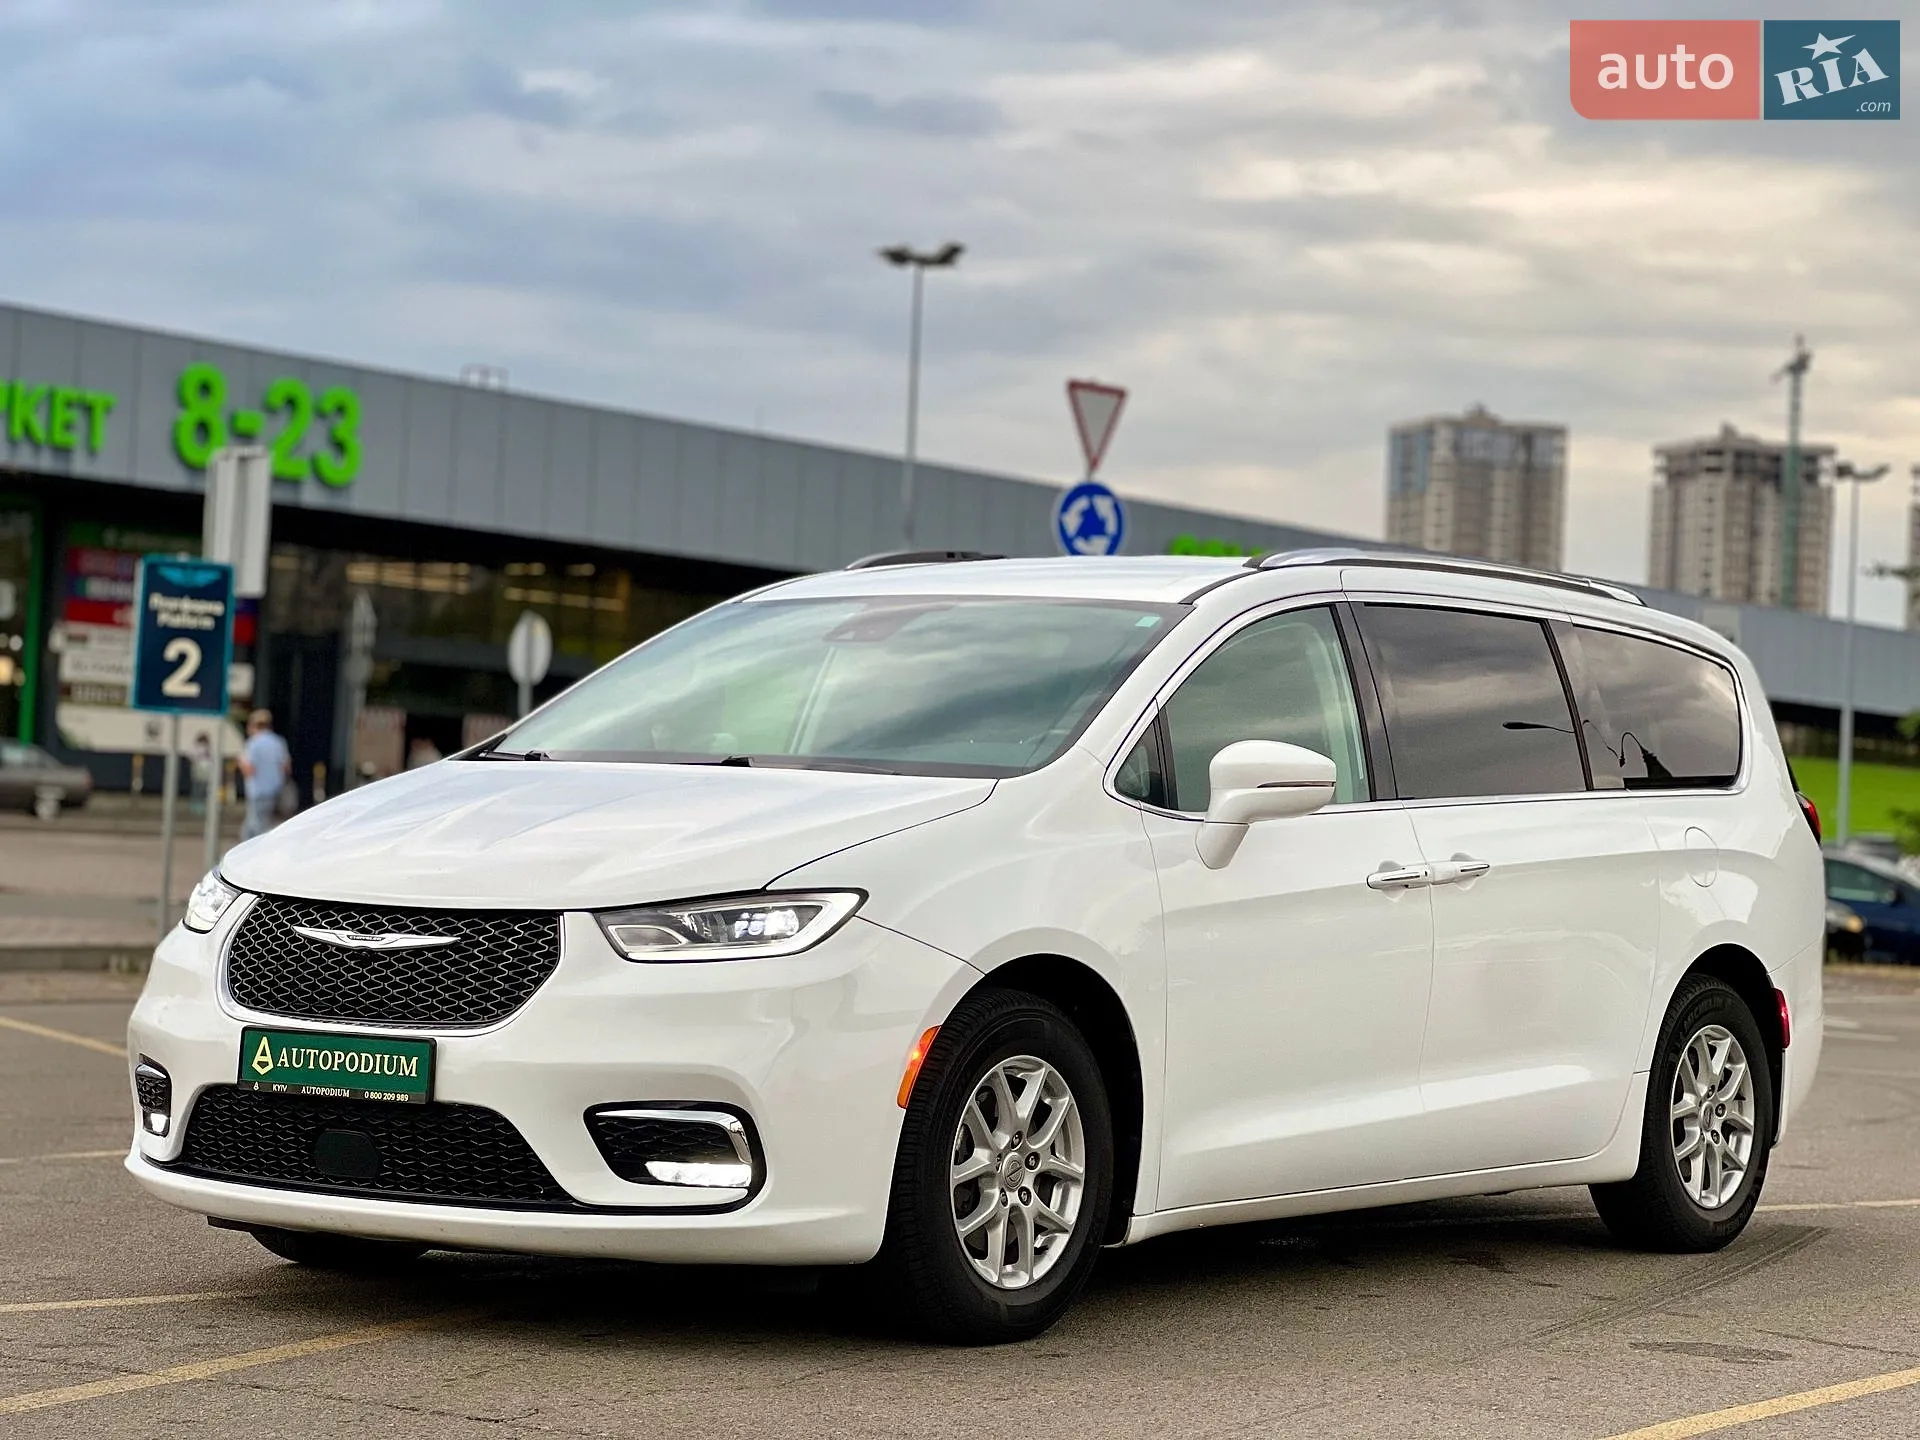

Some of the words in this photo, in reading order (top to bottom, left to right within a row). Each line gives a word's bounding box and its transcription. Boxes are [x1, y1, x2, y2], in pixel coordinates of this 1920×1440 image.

[174, 362, 364, 488] 8-23
[161, 637, 203, 698] 2
[277, 1047, 418, 1077] AUTOPODIUM
[272, 1083, 288, 1093] KYIV
[301, 1086, 350, 1098] AUTOPODIUM
[370, 1091, 382, 1100] 800
[383, 1092, 396, 1101] 209
[396, 1093, 409, 1102] 989
